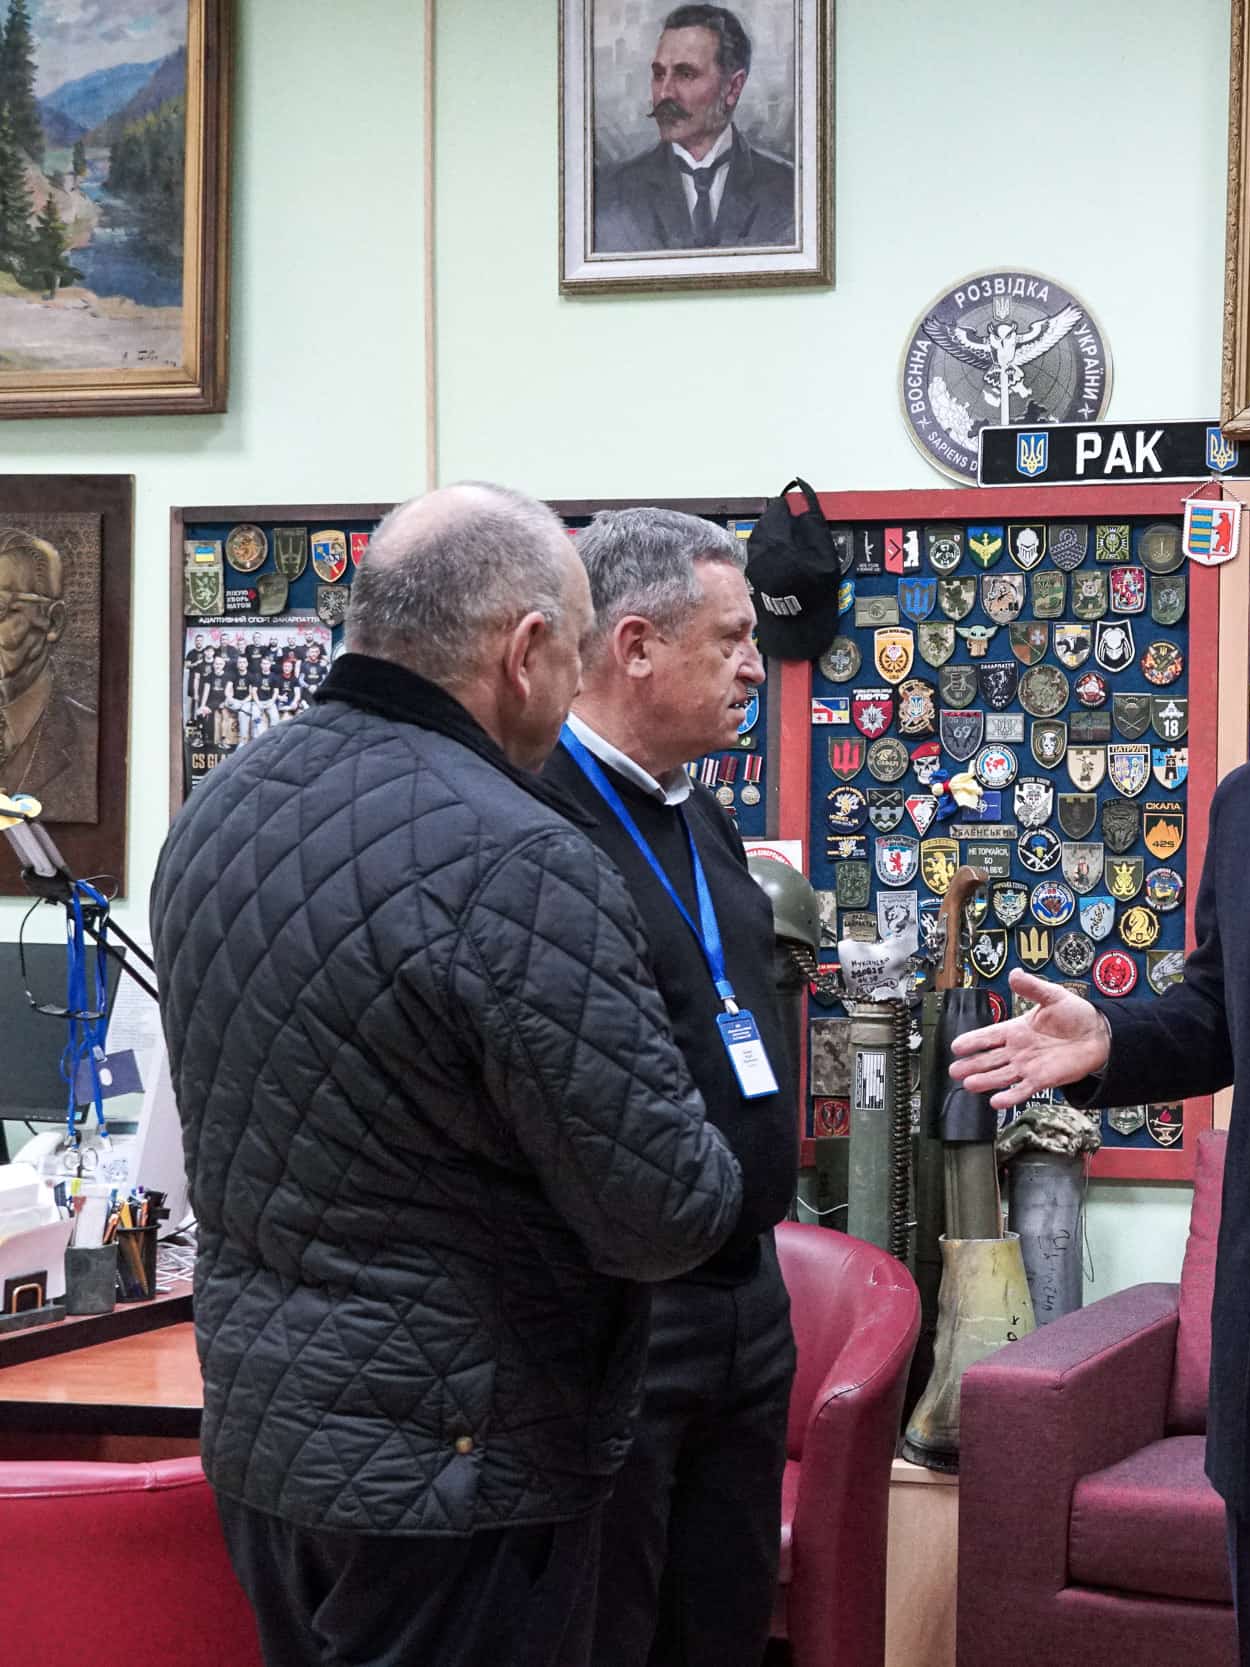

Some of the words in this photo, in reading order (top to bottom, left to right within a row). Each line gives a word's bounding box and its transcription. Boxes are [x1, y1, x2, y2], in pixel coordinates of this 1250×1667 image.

[955, 278, 1050, 309] РОЗВІДКА
[908, 339, 932, 414] ВОЄННА
[1074, 324, 1101, 399] УКРАЇНИ
[928, 431, 969, 468] SAPIENS
[1075, 430, 1164, 475] РАК
[953, 726, 971, 739] 69
[1163, 720, 1179, 737] 18
[1145, 802, 1181, 811] СКАЛА
